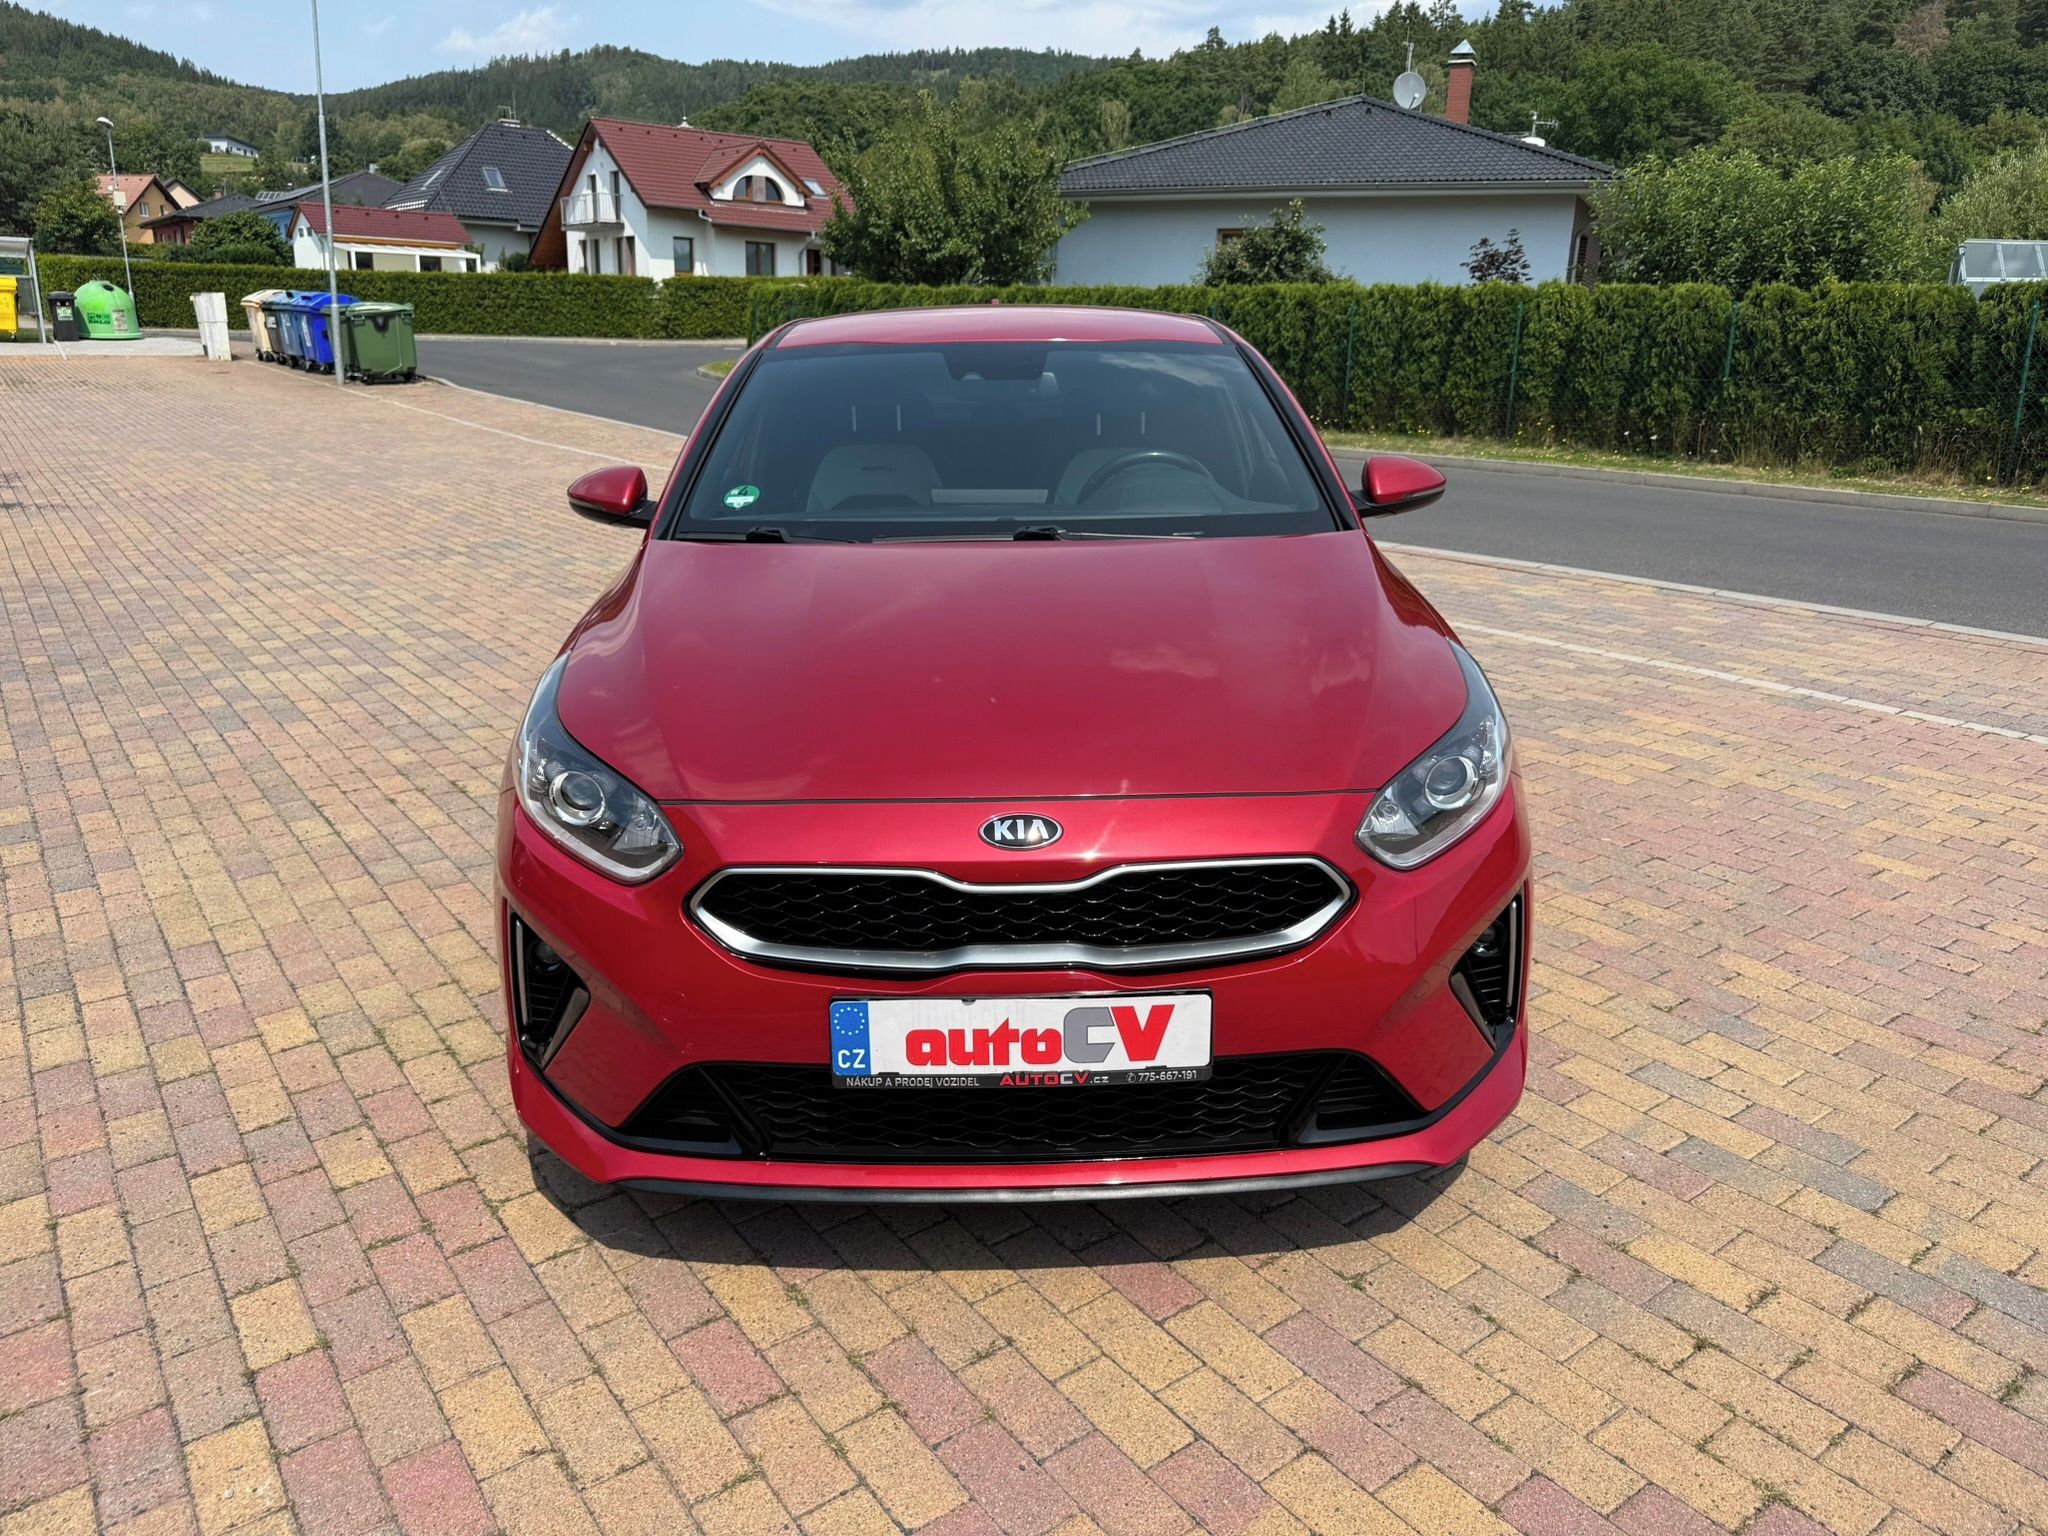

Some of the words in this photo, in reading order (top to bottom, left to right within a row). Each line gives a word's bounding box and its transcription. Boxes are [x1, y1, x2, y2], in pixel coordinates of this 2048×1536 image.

[993, 819, 1050, 841] KIA
[905, 1004, 1176, 1067] autoCV
[837, 1048, 866, 1070] CZ
[846, 1075, 883, 1087] NÁKUP
[885, 1077, 893, 1087] A
[895, 1077, 933, 1088] PRODEJ
[936, 1077, 980, 1087] VOZIDEL
[1137, 1070, 1197, 1082] 775-667-191
